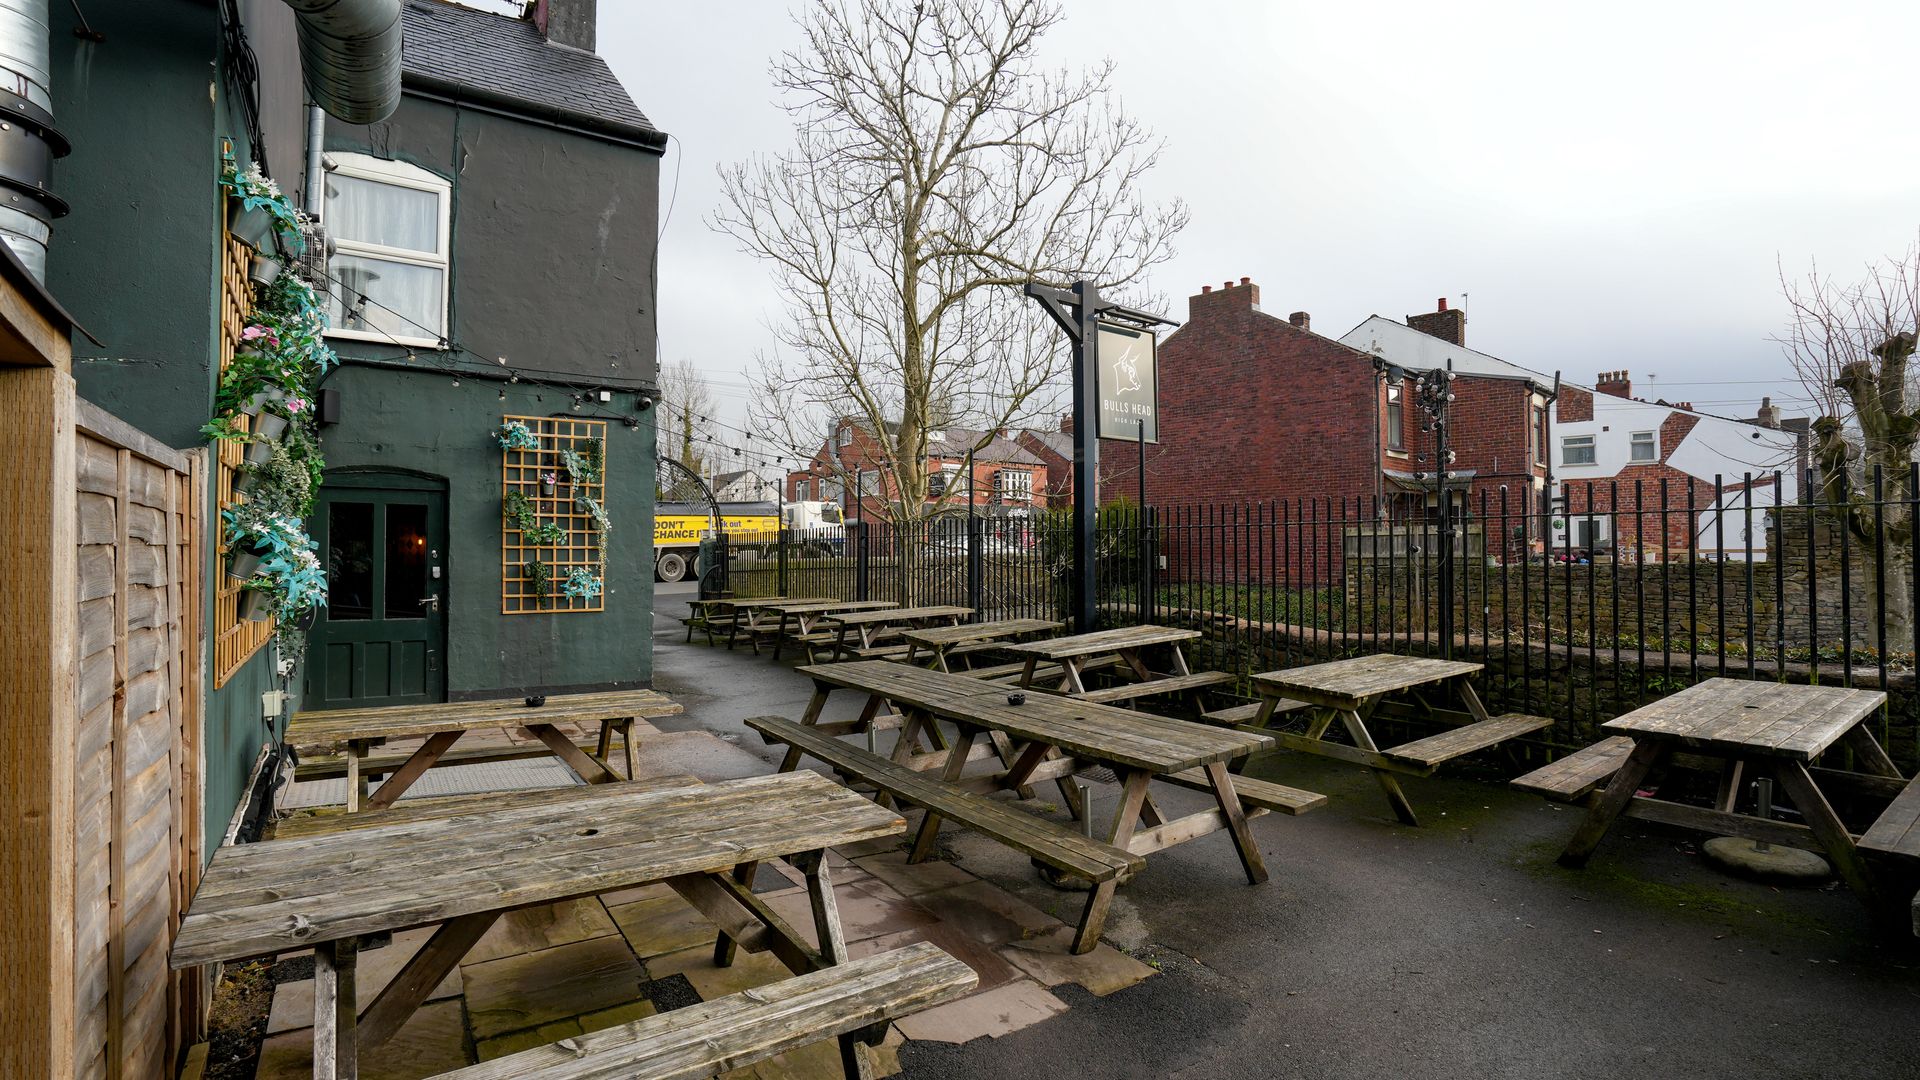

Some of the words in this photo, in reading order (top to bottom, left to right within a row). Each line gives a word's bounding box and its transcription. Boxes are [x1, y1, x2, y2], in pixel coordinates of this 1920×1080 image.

[1104, 400, 1129, 413] BULLS
[1132, 403, 1151, 416] HEAD
[655, 520, 685, 529] DON'T
[730, 520, 741, 528] out
[653, 529, 695, 539] CHANCE
